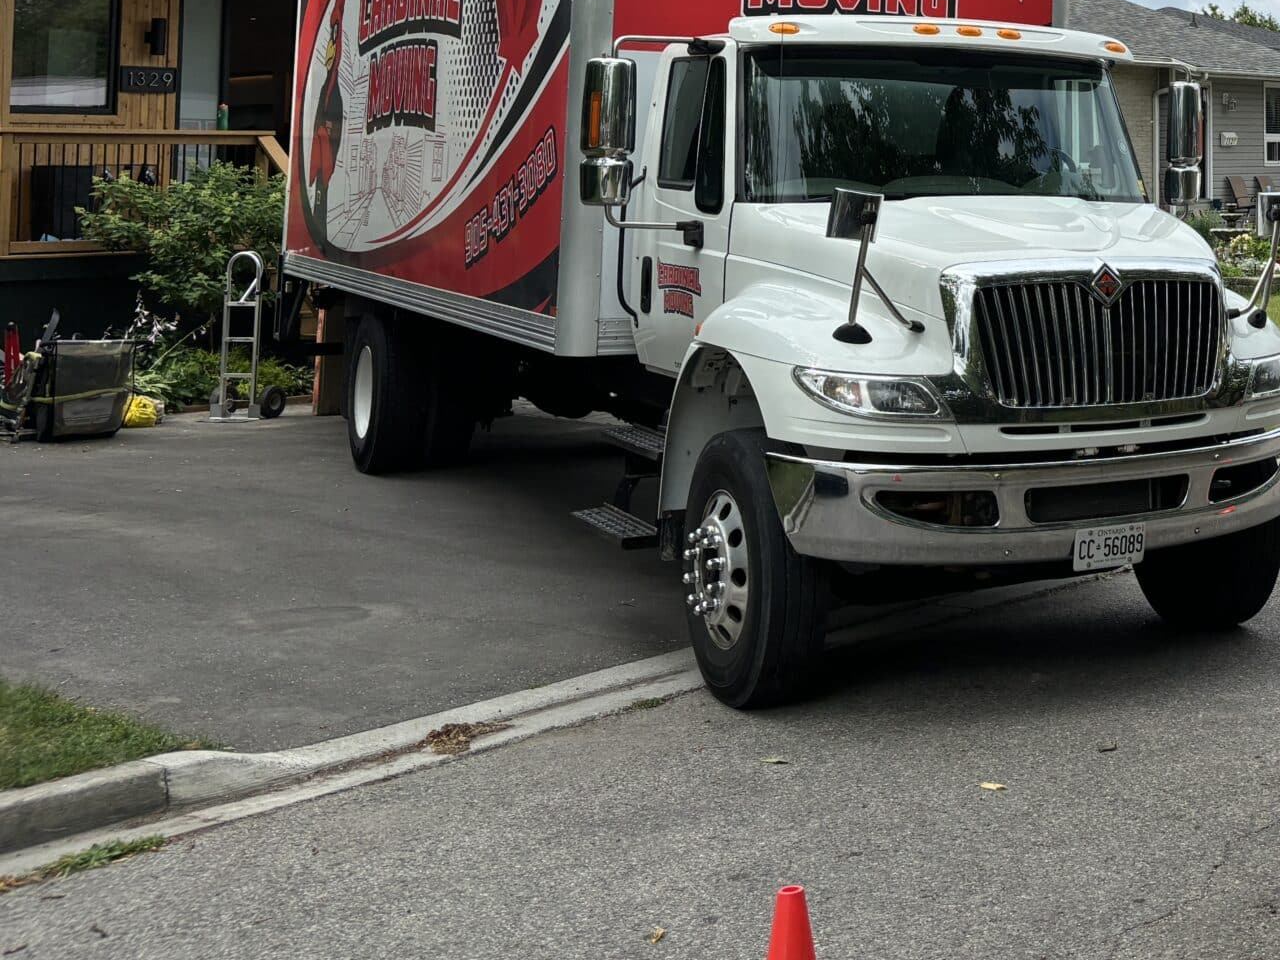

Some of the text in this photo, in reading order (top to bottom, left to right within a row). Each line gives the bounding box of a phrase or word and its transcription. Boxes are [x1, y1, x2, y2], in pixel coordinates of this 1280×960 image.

[130, 71, 173, 87] 1329
[367, 40, 437, 133] MOVING
[464, 126, 558, 268] 905-431-3080
[657, 257, 701, 296] CARDINAL
